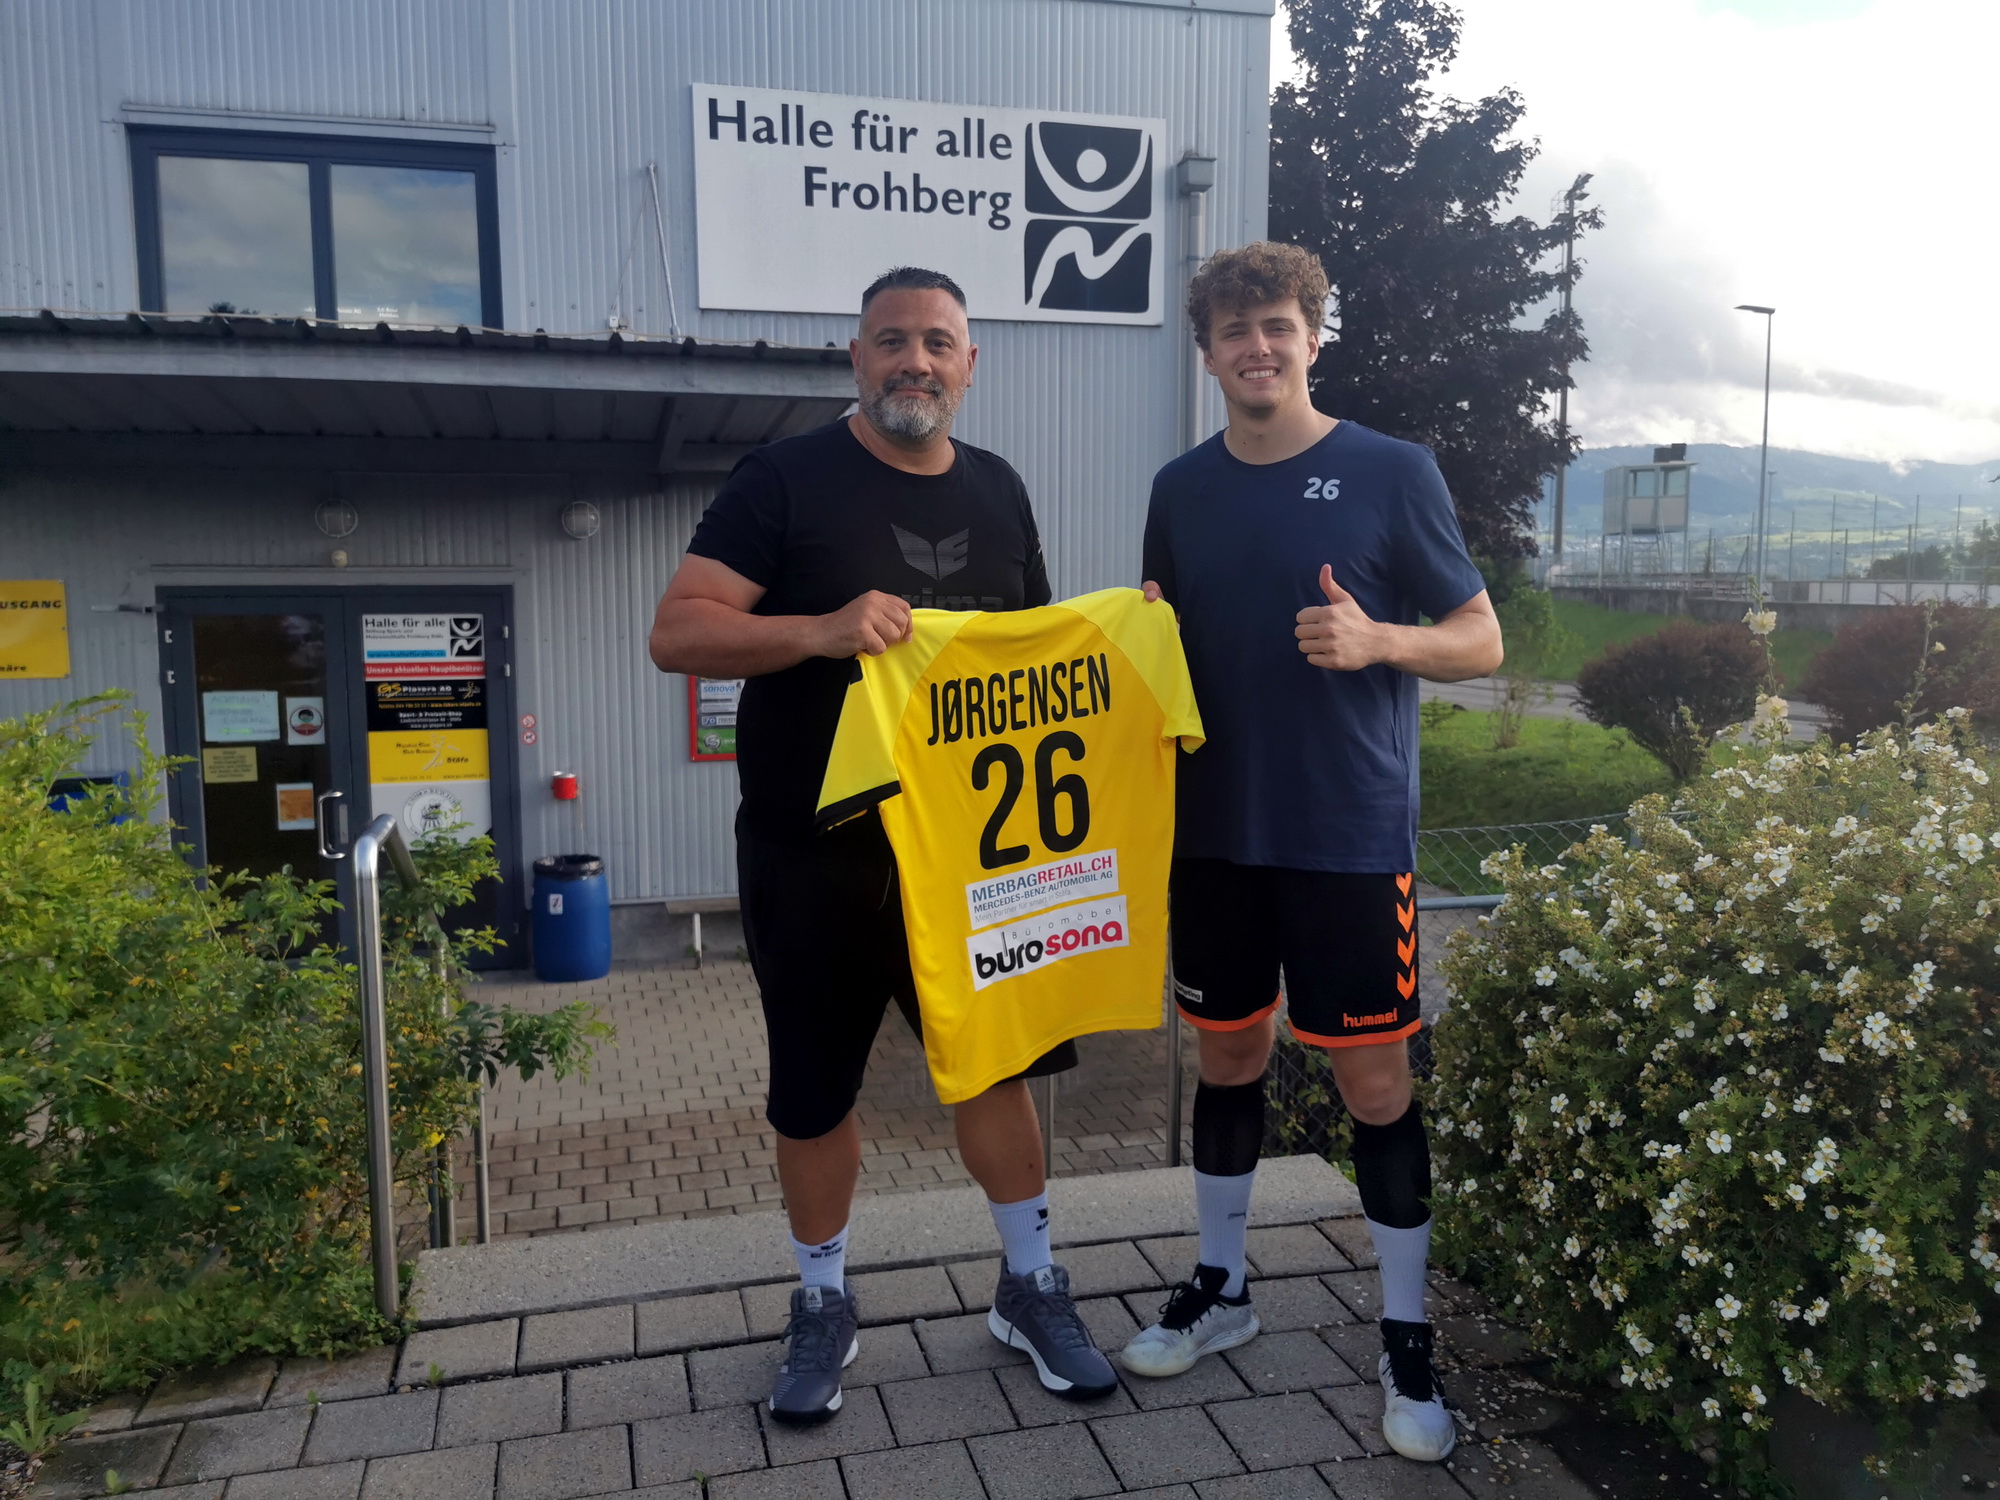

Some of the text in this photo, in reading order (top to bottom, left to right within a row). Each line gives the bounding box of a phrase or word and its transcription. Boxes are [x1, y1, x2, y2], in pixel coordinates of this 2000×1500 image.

[708, 98, 1013, 160] Halle für alle
[804, 166, 1012, 230] Frohberg
[1303, 476, 1341, 501] 26
[365, 617, 446, 628] Halle für alle
[704, 685, 735, 693] sonova
[927, 653, 1111, 746] JØRGENSEN
[971, 730, 1091, 870] 26
[972, 855, 1112, 903] MERBAGRETAIL.CH
[974, 870, 1113, 914] MERCEDES-BENZ AUTOMOBIL AG
[1343, 1007, 1398, 1028] hummel
